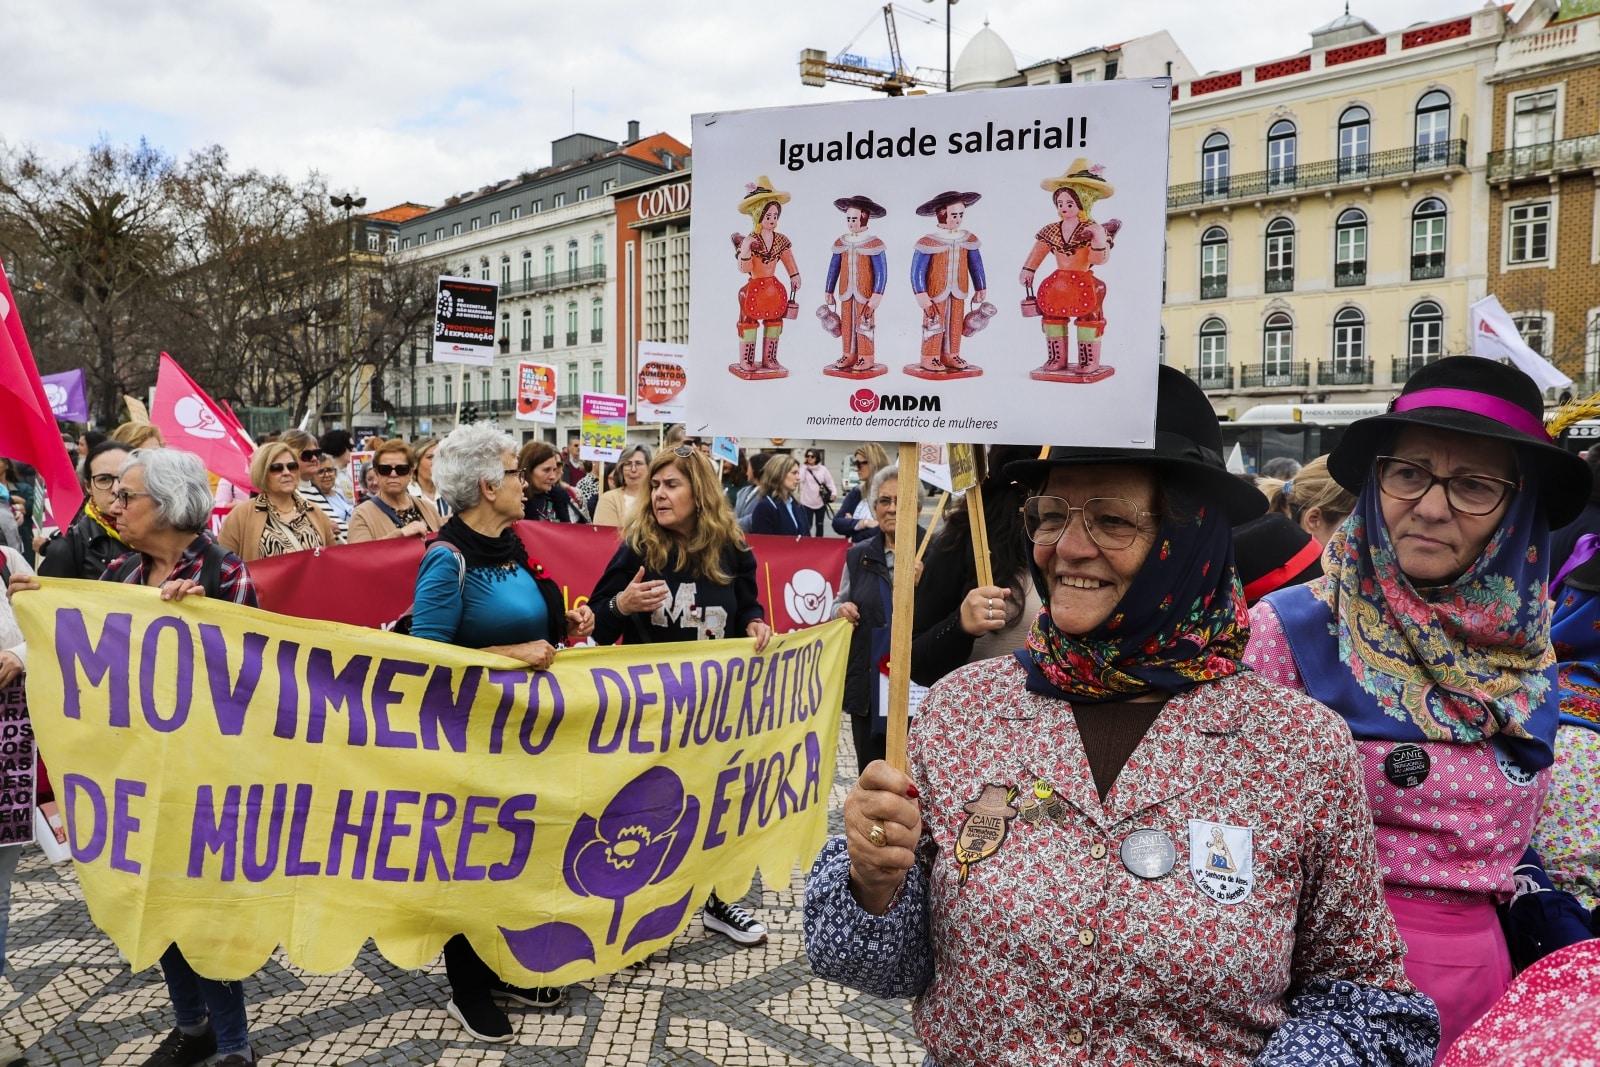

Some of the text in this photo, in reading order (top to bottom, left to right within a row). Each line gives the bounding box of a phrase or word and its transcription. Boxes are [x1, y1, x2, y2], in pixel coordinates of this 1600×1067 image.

[779, 116, 1087, 171] Igualdade salarial!
[449, 331, 494, 341] EXPLORAÇÃO
[645, 362, 675, 370] CONTRA
[654, 387, 673, 395] VIDA
[880, 394, 942, 412] MDM
[806, 414, 999, 430] movimento democrático de mulheres
[55, 607, 824, 756] MOVIMENTO DEMOCRÁTICO
[1392, 750, 1424, 762] CANTE
[62, 772, 538, 883] DE MULHERES
[972, 815, 1002, 828] CANTE
[1128, 834, 1167, 847] CANTE
[1199, 877, 1216, 895] Viana
[1217, 891, 1225, 900] do
[1219, 883, 1227, 891] de
